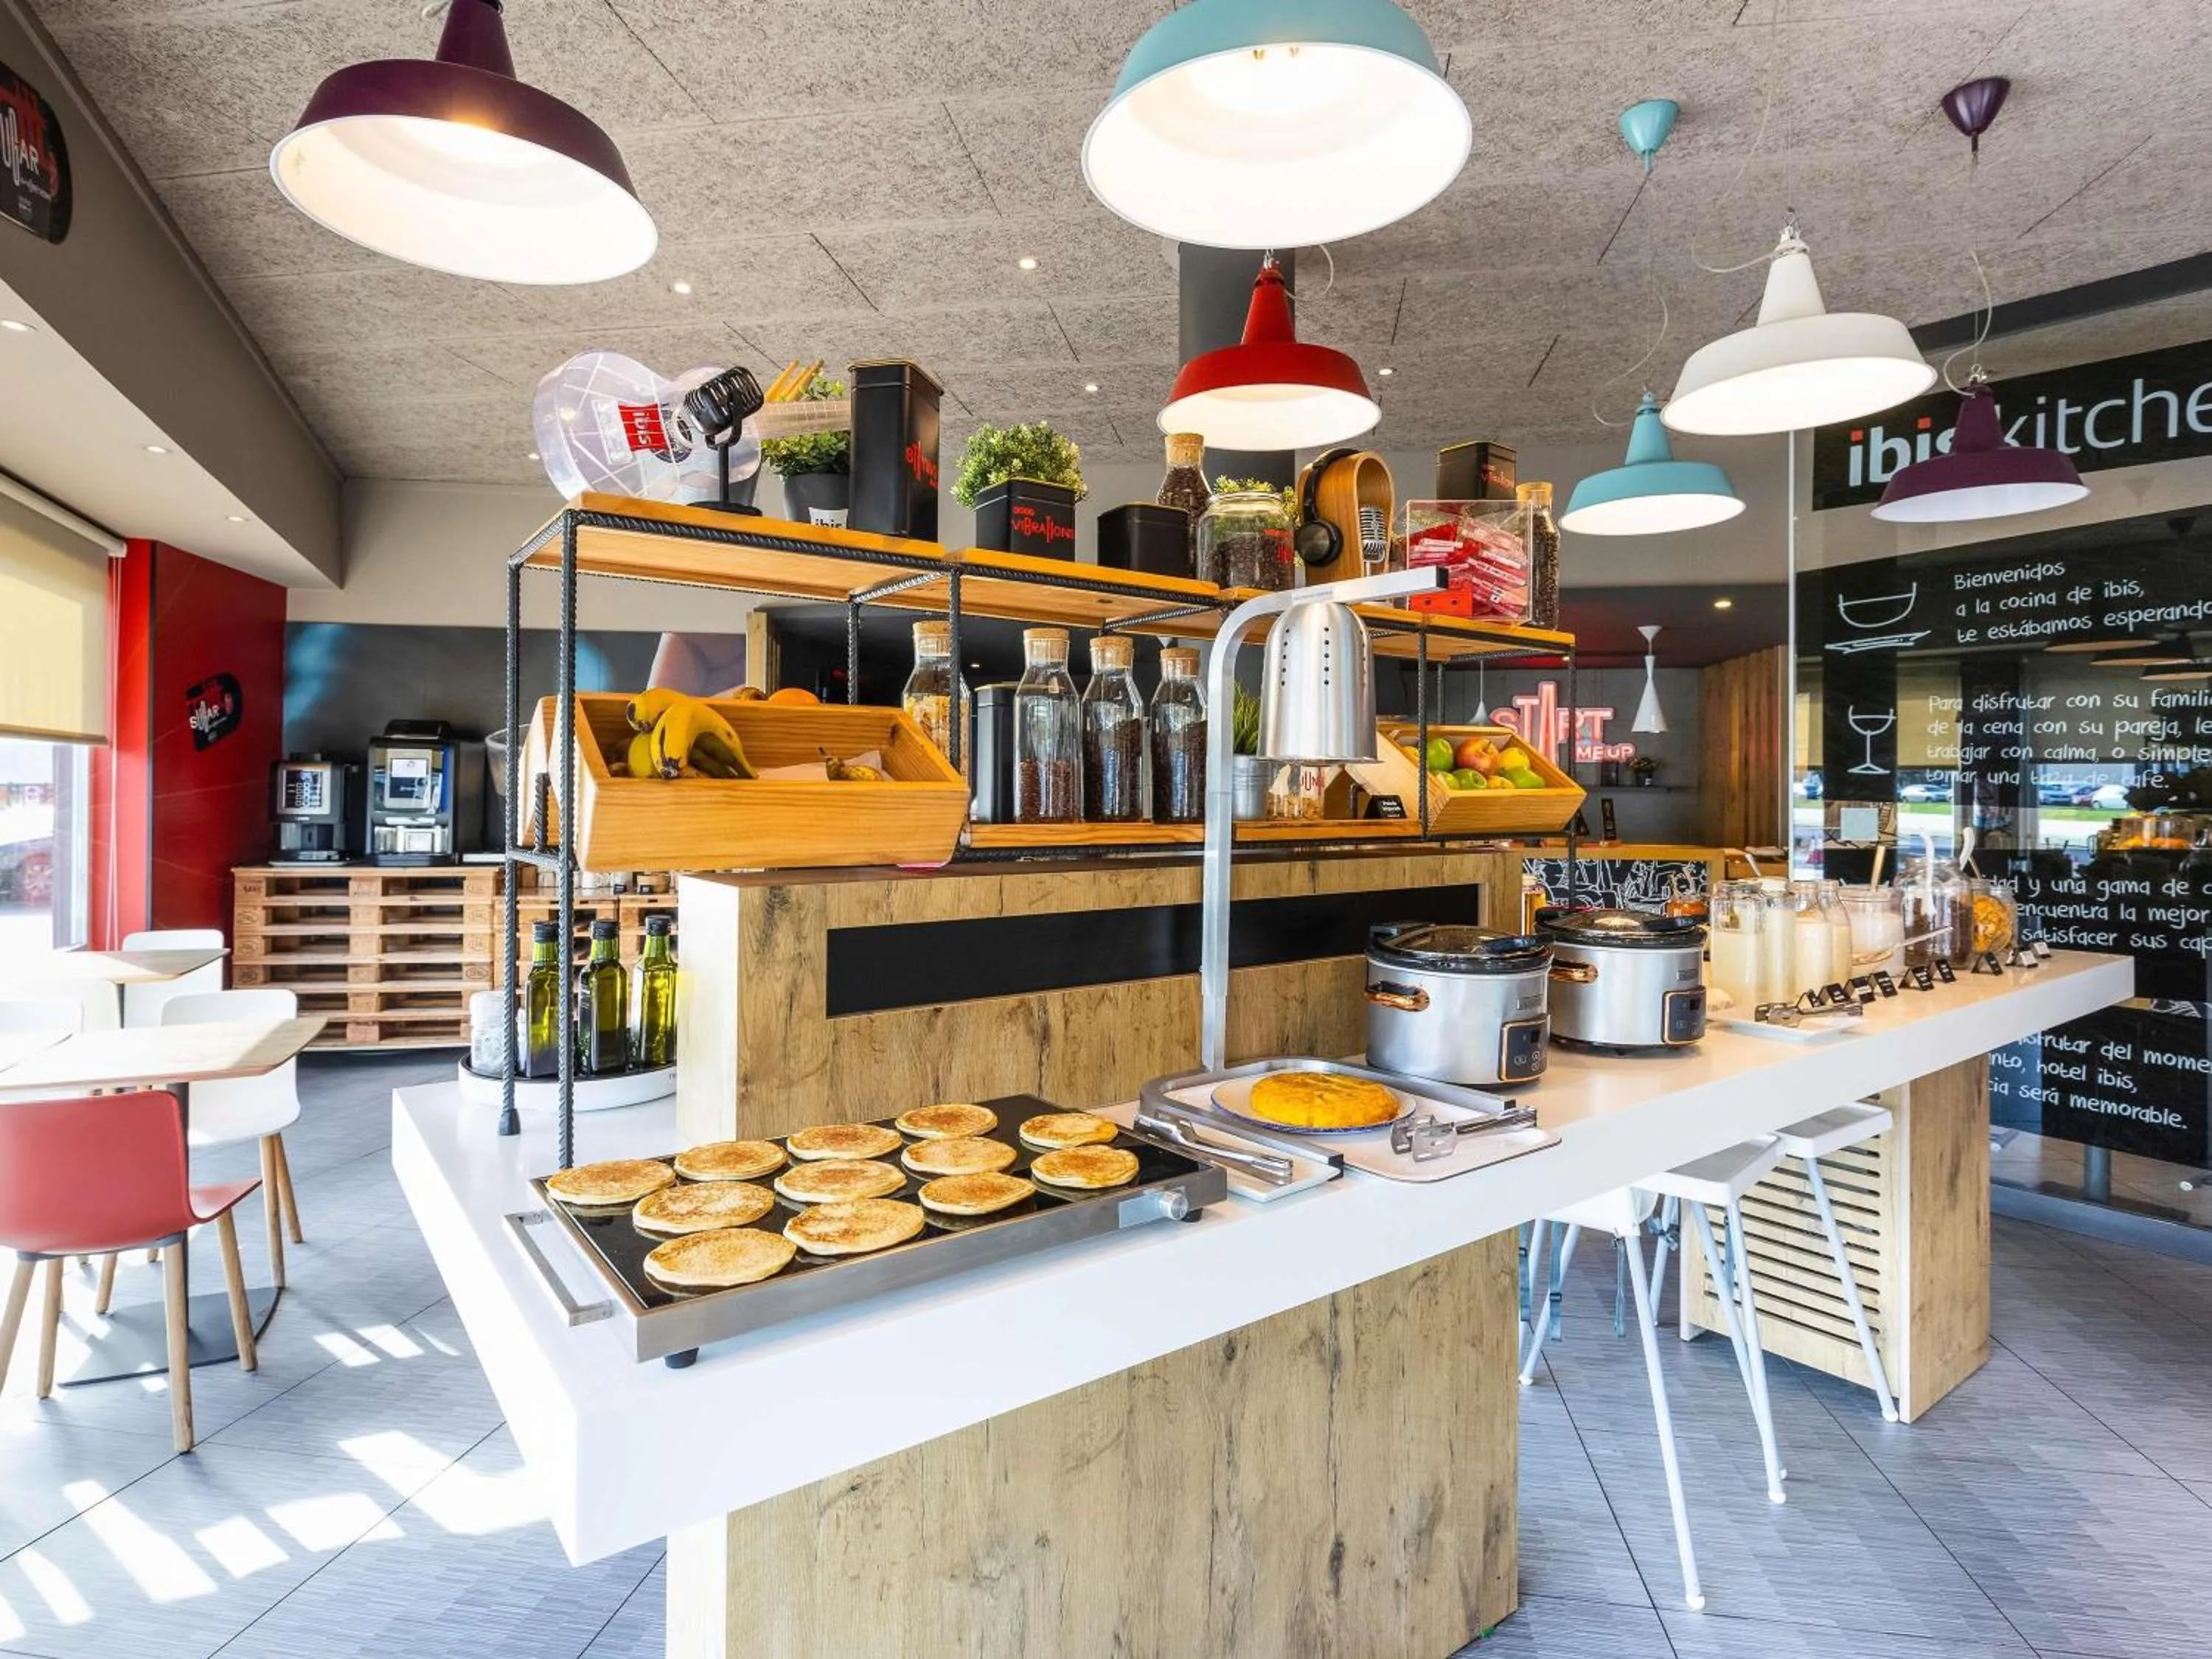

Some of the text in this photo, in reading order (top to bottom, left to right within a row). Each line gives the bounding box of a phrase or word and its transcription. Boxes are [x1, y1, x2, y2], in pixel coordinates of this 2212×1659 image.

[1955, 562, 2065, 590] Bienvenidos
[1956, 580, 2144, 616] a la cocina de ibis,
[1958, 628, 1978, 643] te
[1987, 618, 2092, 639] estábamos
[1929, 688, 2212, 712] Para disfrutar con su famili
[1927, 720, 1949, 735] de
[1958, 719, 1973, 734] la
[1983, 720, 2023, 734] cena
[2034, 720, 2067, 734] con
[2079, 720, 2103, 734] su
[2115, 717, 2182, 742] pareja,
[1576, 745, 1603, 762] ME
[1927, 743, 1991, 765] trabajar
[2000, 745, 2033, 759] con
[2044, 744, 2099, 763] calma,
[2112, 746, 2125, 759] o
[1925, 768, 1977, 784] tomar
[1987, 771, 2020, 785] una
[2031, 771, 2073, 785] taza
[2086, 771, 2108, 787] de
[2028, 879, 2040, 897] y
[2051, 879, 2086, 894] una
[2096, 879, 2150, 902] gama
[2162, 878, 2190, 897] de
[2017, 903, 2211, 929] encuentra la mejor
[2021, 925, 2118, 946] satisfacer
[2129, 933, 2168, 949] sus
[2101, 1041, 2131, 1060] del
[2143, 1049, 2212, 1074] mome
[1989, 1052, 2138, 1093] nto, hotel ibis,
[2018, 1085, 2059, 1105] será
[2070, 1094, 2188, 1129] memorable.
